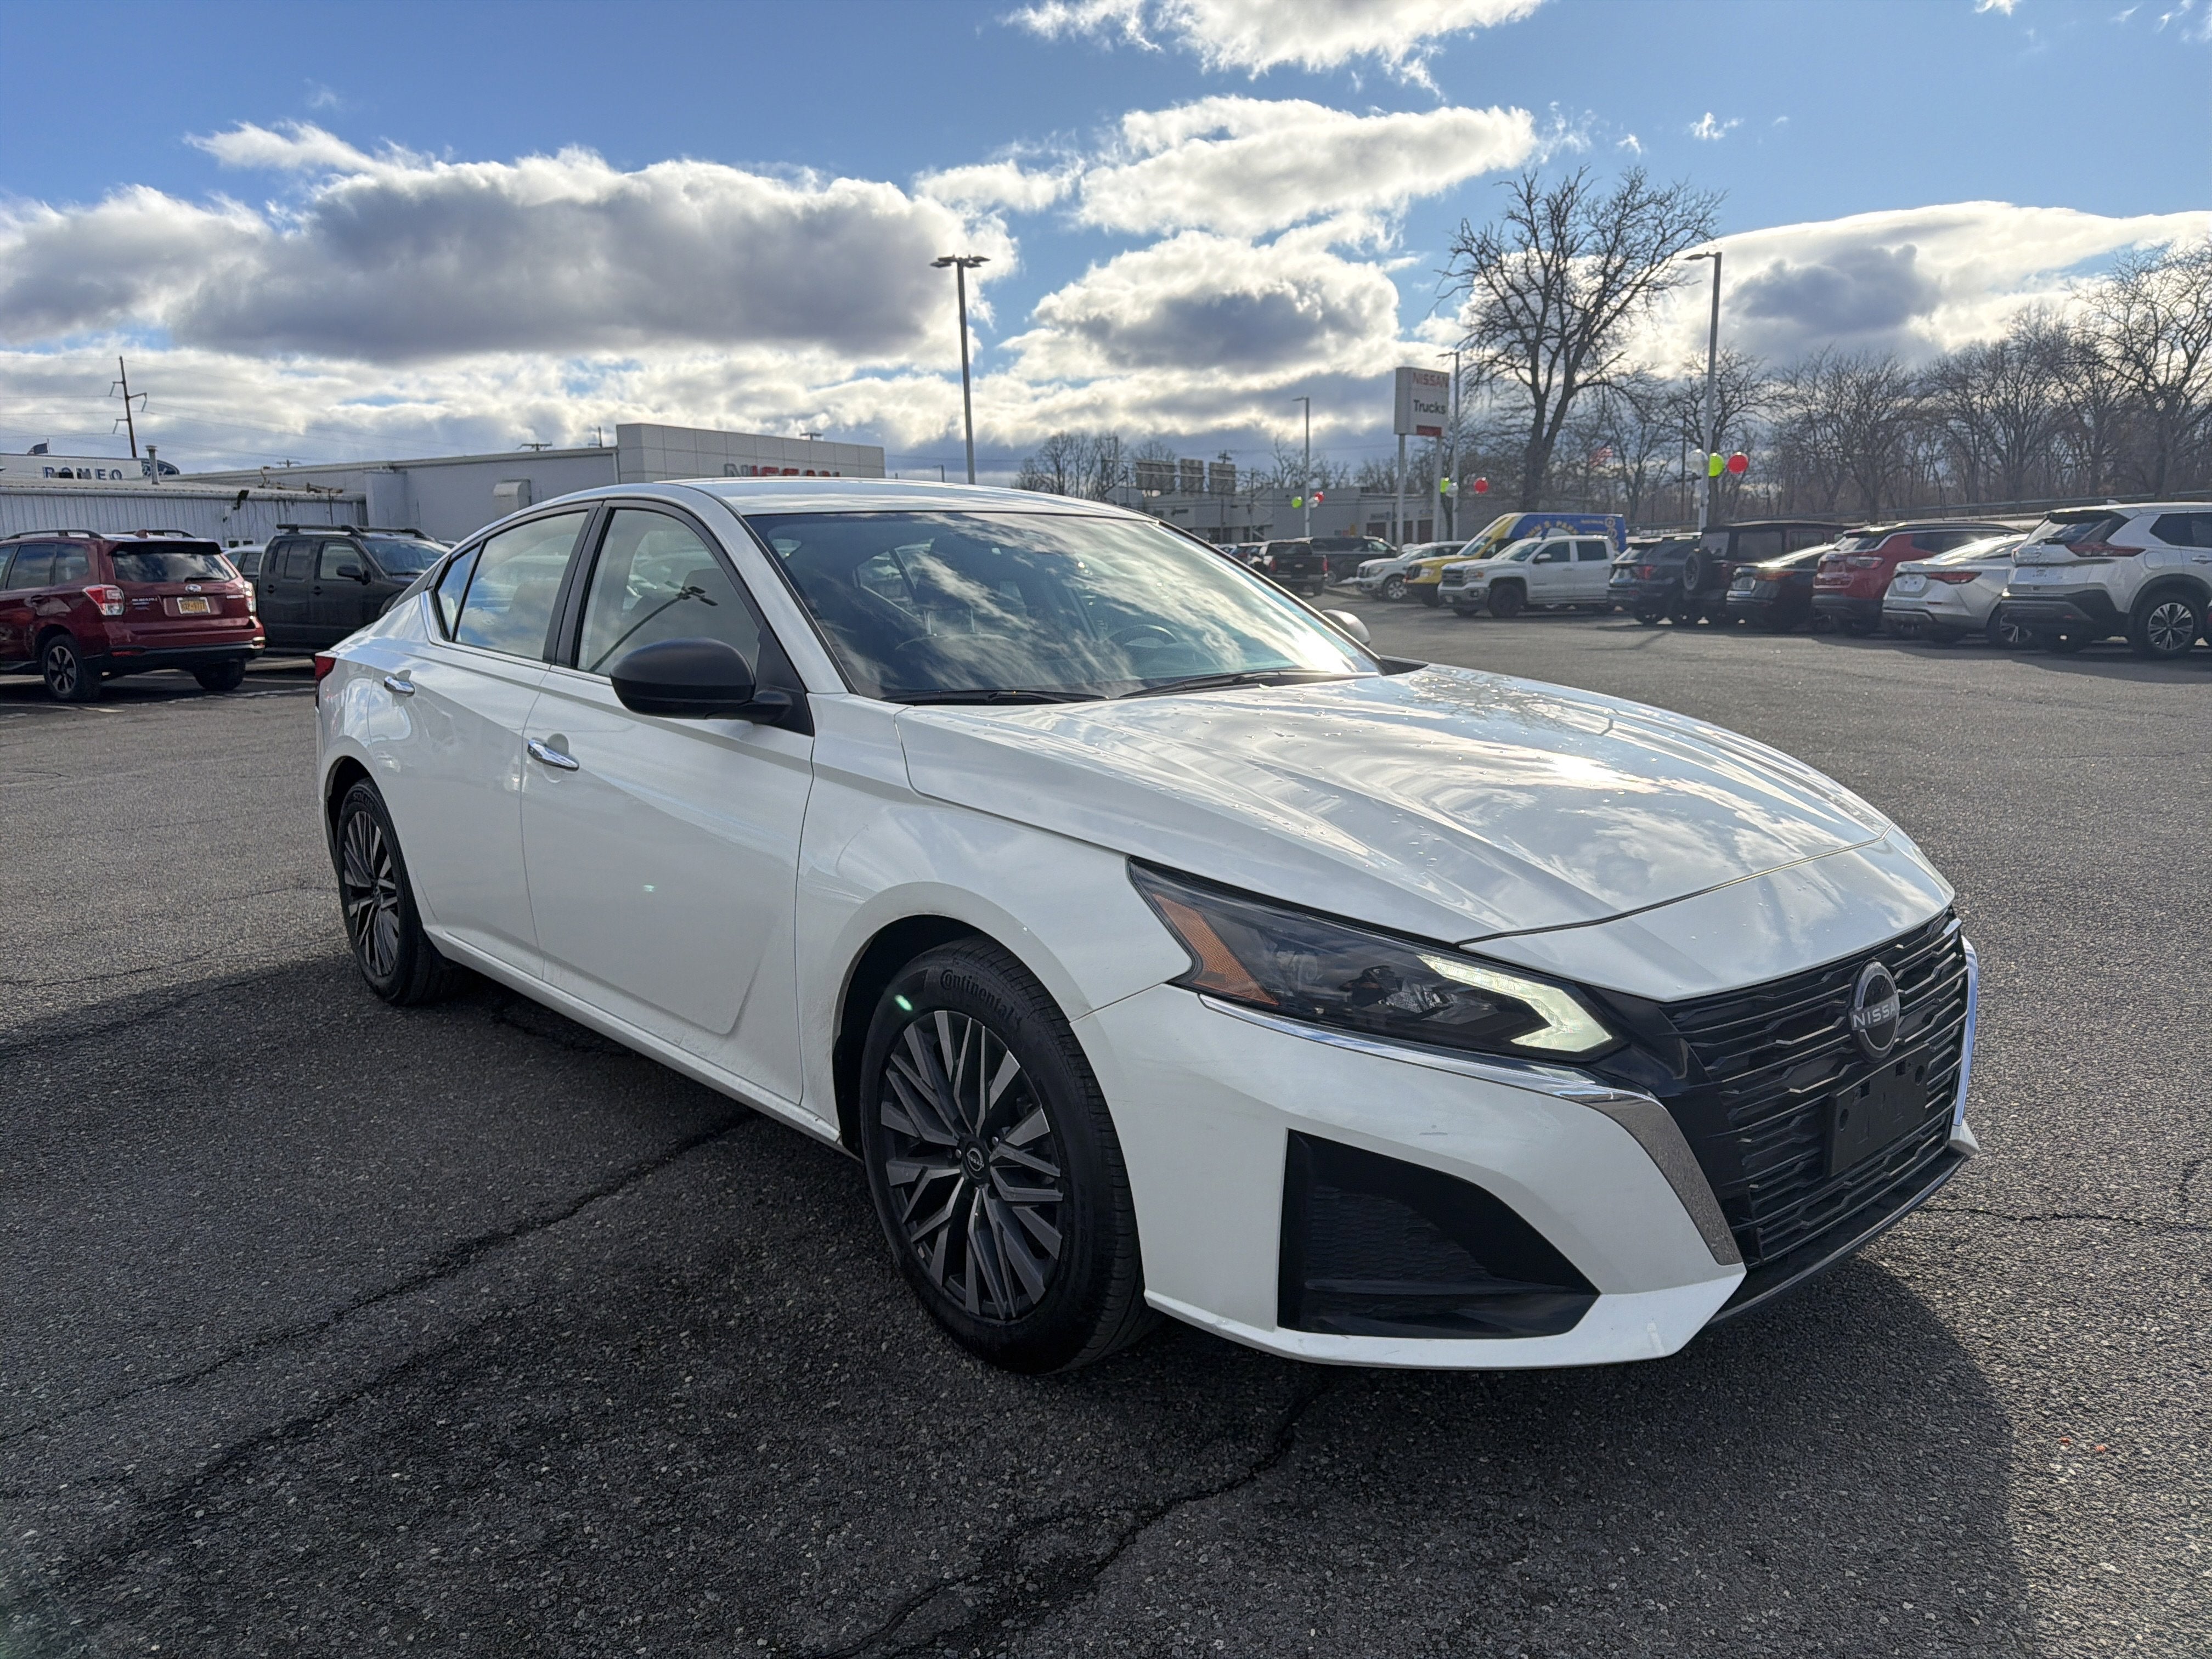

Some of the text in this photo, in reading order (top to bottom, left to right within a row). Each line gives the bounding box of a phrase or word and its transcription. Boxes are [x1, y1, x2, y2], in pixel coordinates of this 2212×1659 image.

[1413, 371, 1448, 387] NISSAN
[1413, 399, 1446, 415] Trucks
[1853, 1000, 1898, 1028] NISSA
